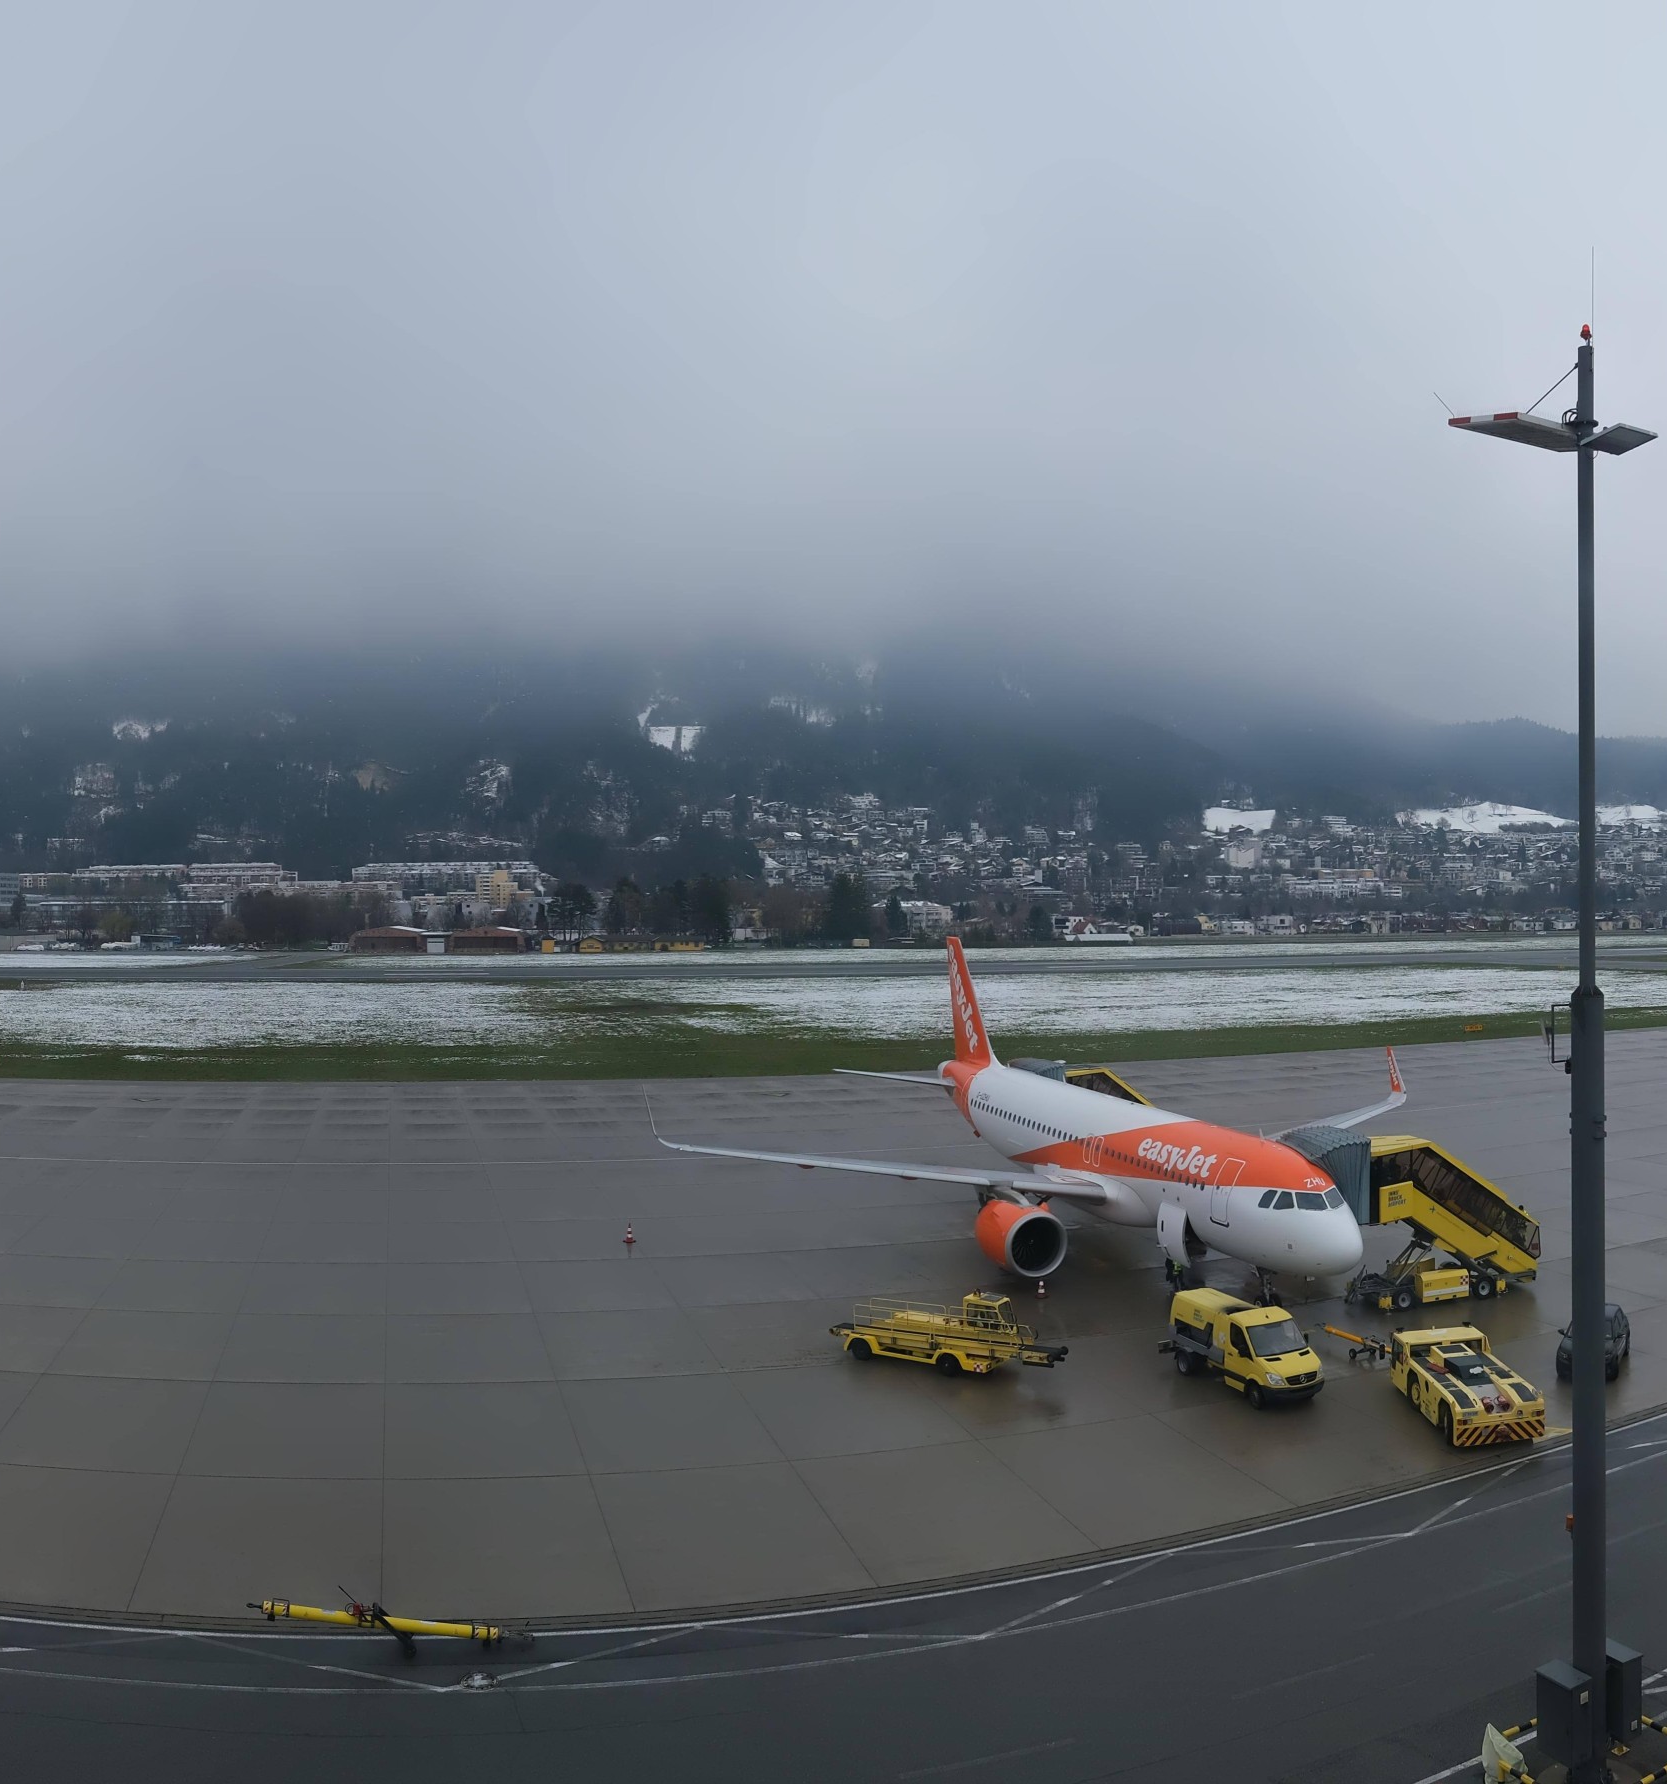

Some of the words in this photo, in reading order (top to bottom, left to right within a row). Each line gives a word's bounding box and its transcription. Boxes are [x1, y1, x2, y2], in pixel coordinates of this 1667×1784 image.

[949, 944, 978, 1054] easyJet
[1138, 1138, 1218, 1178] easyJet
[1304, 1177, 1326, 1188] ZHU
